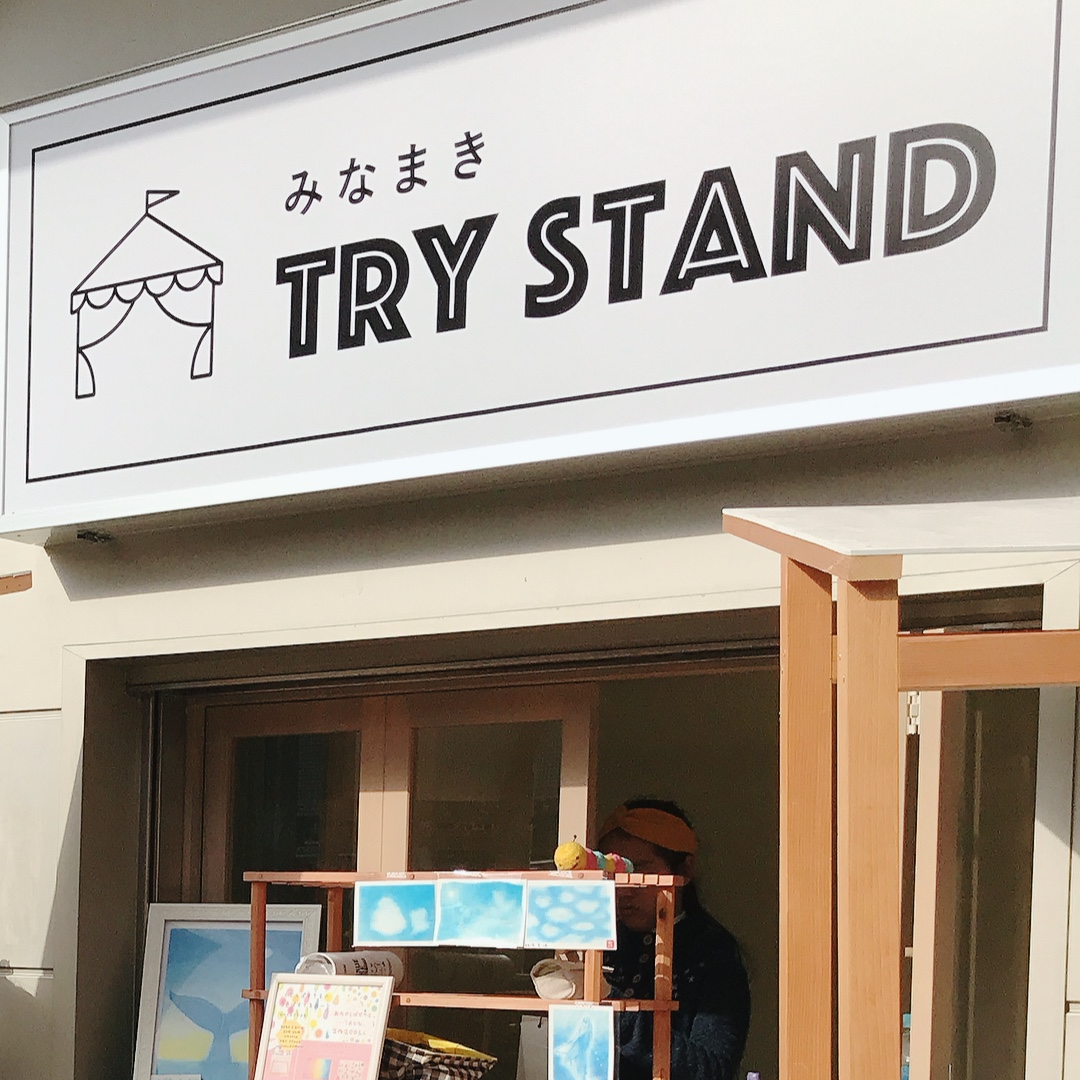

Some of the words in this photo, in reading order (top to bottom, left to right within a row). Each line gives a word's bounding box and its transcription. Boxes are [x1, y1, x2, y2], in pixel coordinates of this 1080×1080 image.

[275, 213, 499, 359] TRY
[525, 121, 996, 319] STAND
[284, 130, 487, 215] みなまき
